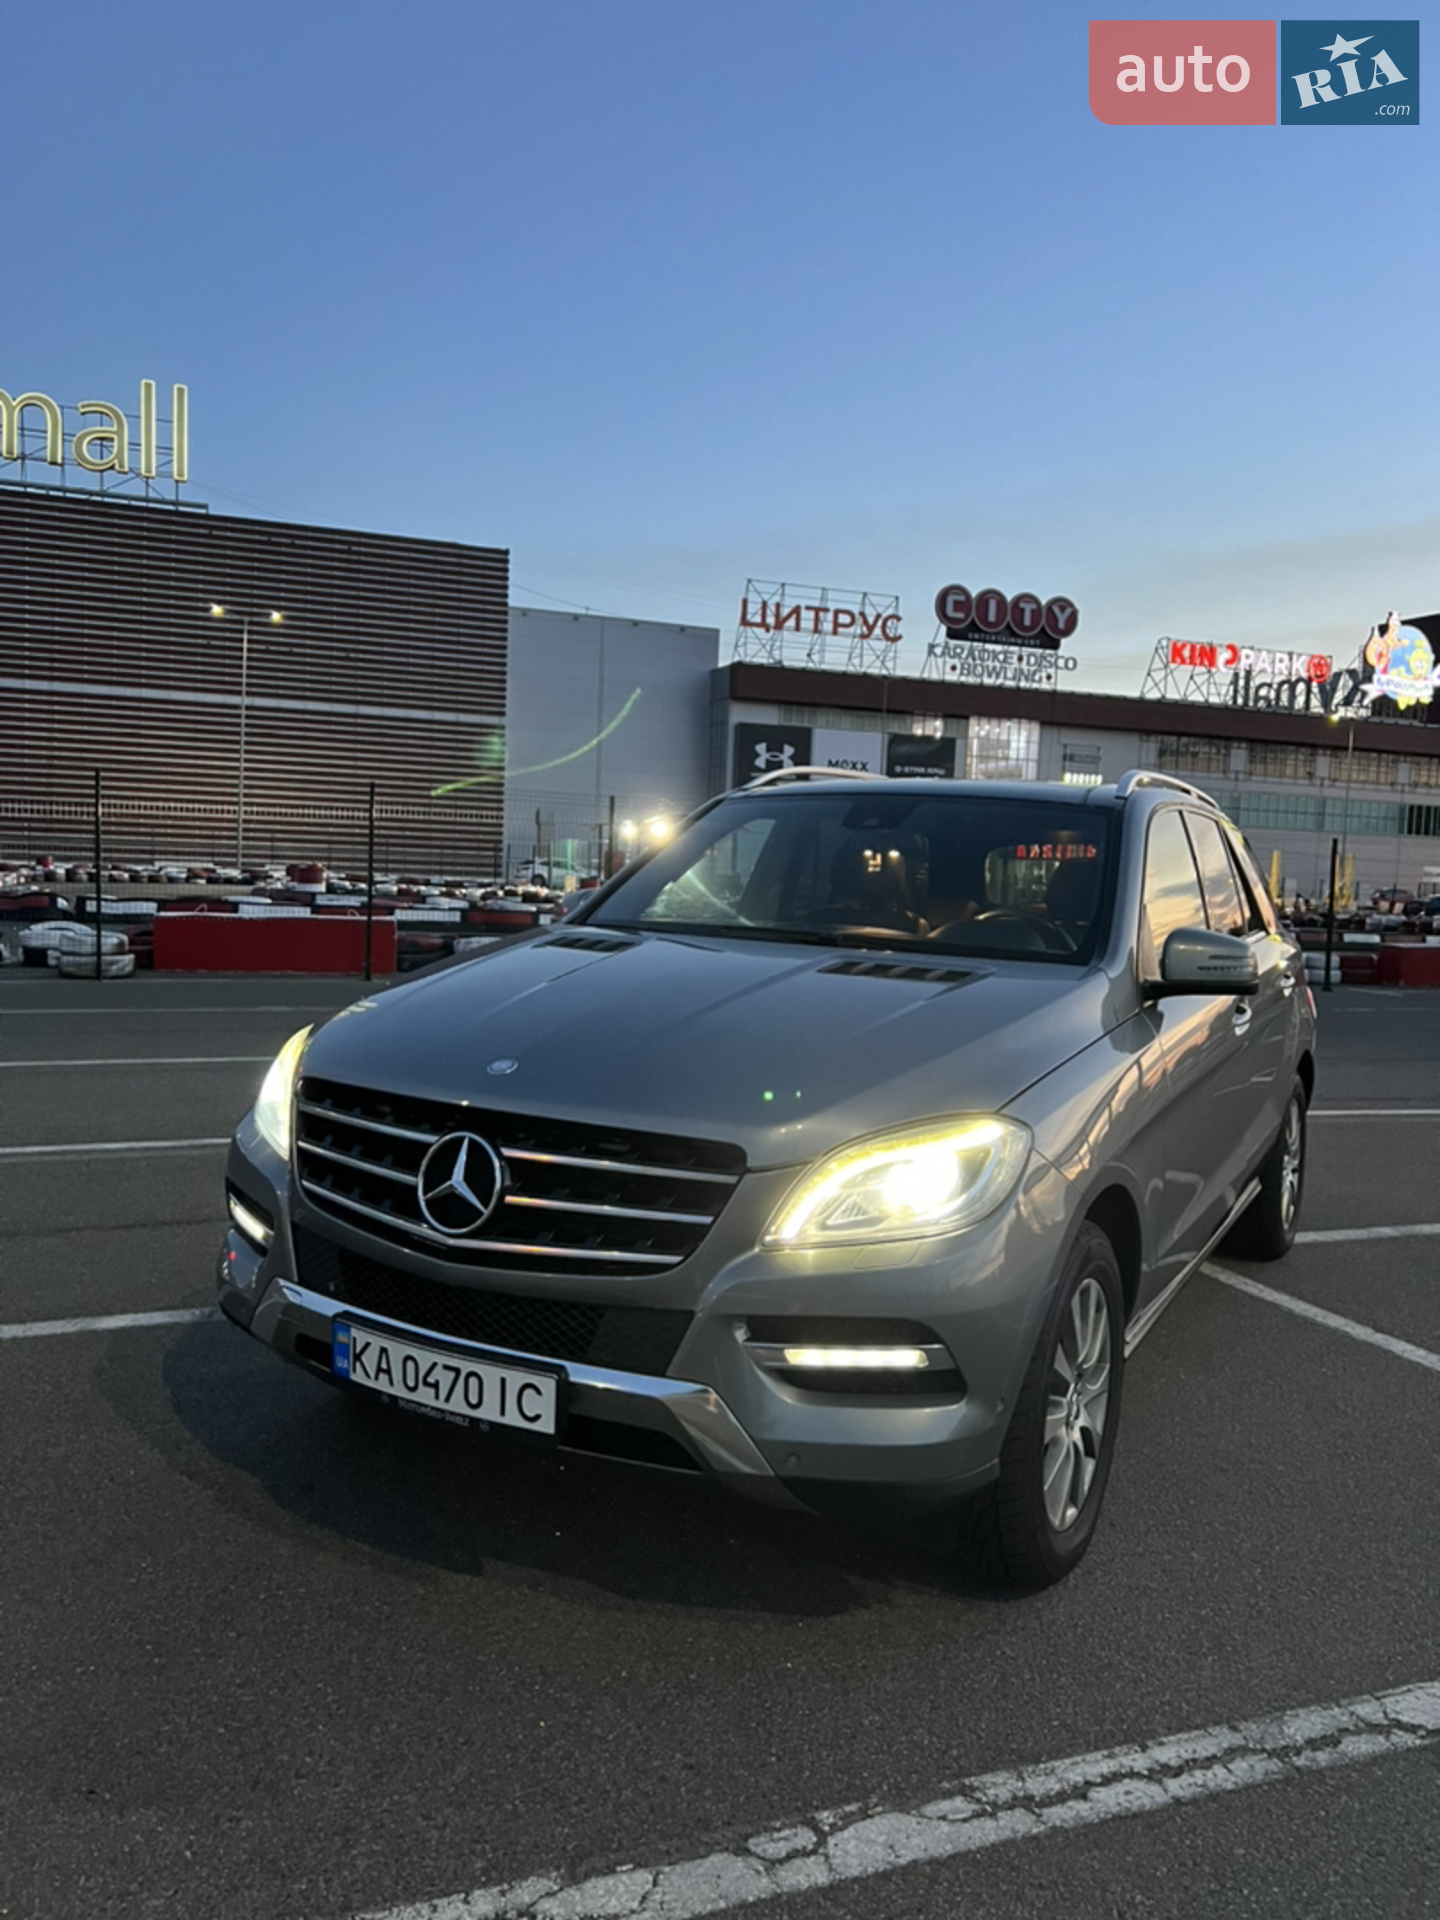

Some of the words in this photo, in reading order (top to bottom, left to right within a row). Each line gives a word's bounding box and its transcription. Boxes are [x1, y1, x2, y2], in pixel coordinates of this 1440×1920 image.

[0, 378, 189, 483] mall
[740, 597, 903, 643] ЦИТРУС
[945, 594, 1074, 630] CITY
[968, 632, 1041, 646] ENTERTAINMENT
[928, 642, 1015, 665] KARAOKE
[1026, 653, 1078, 672] DISCO
[959, 662, 1042, 684] BOWLING
